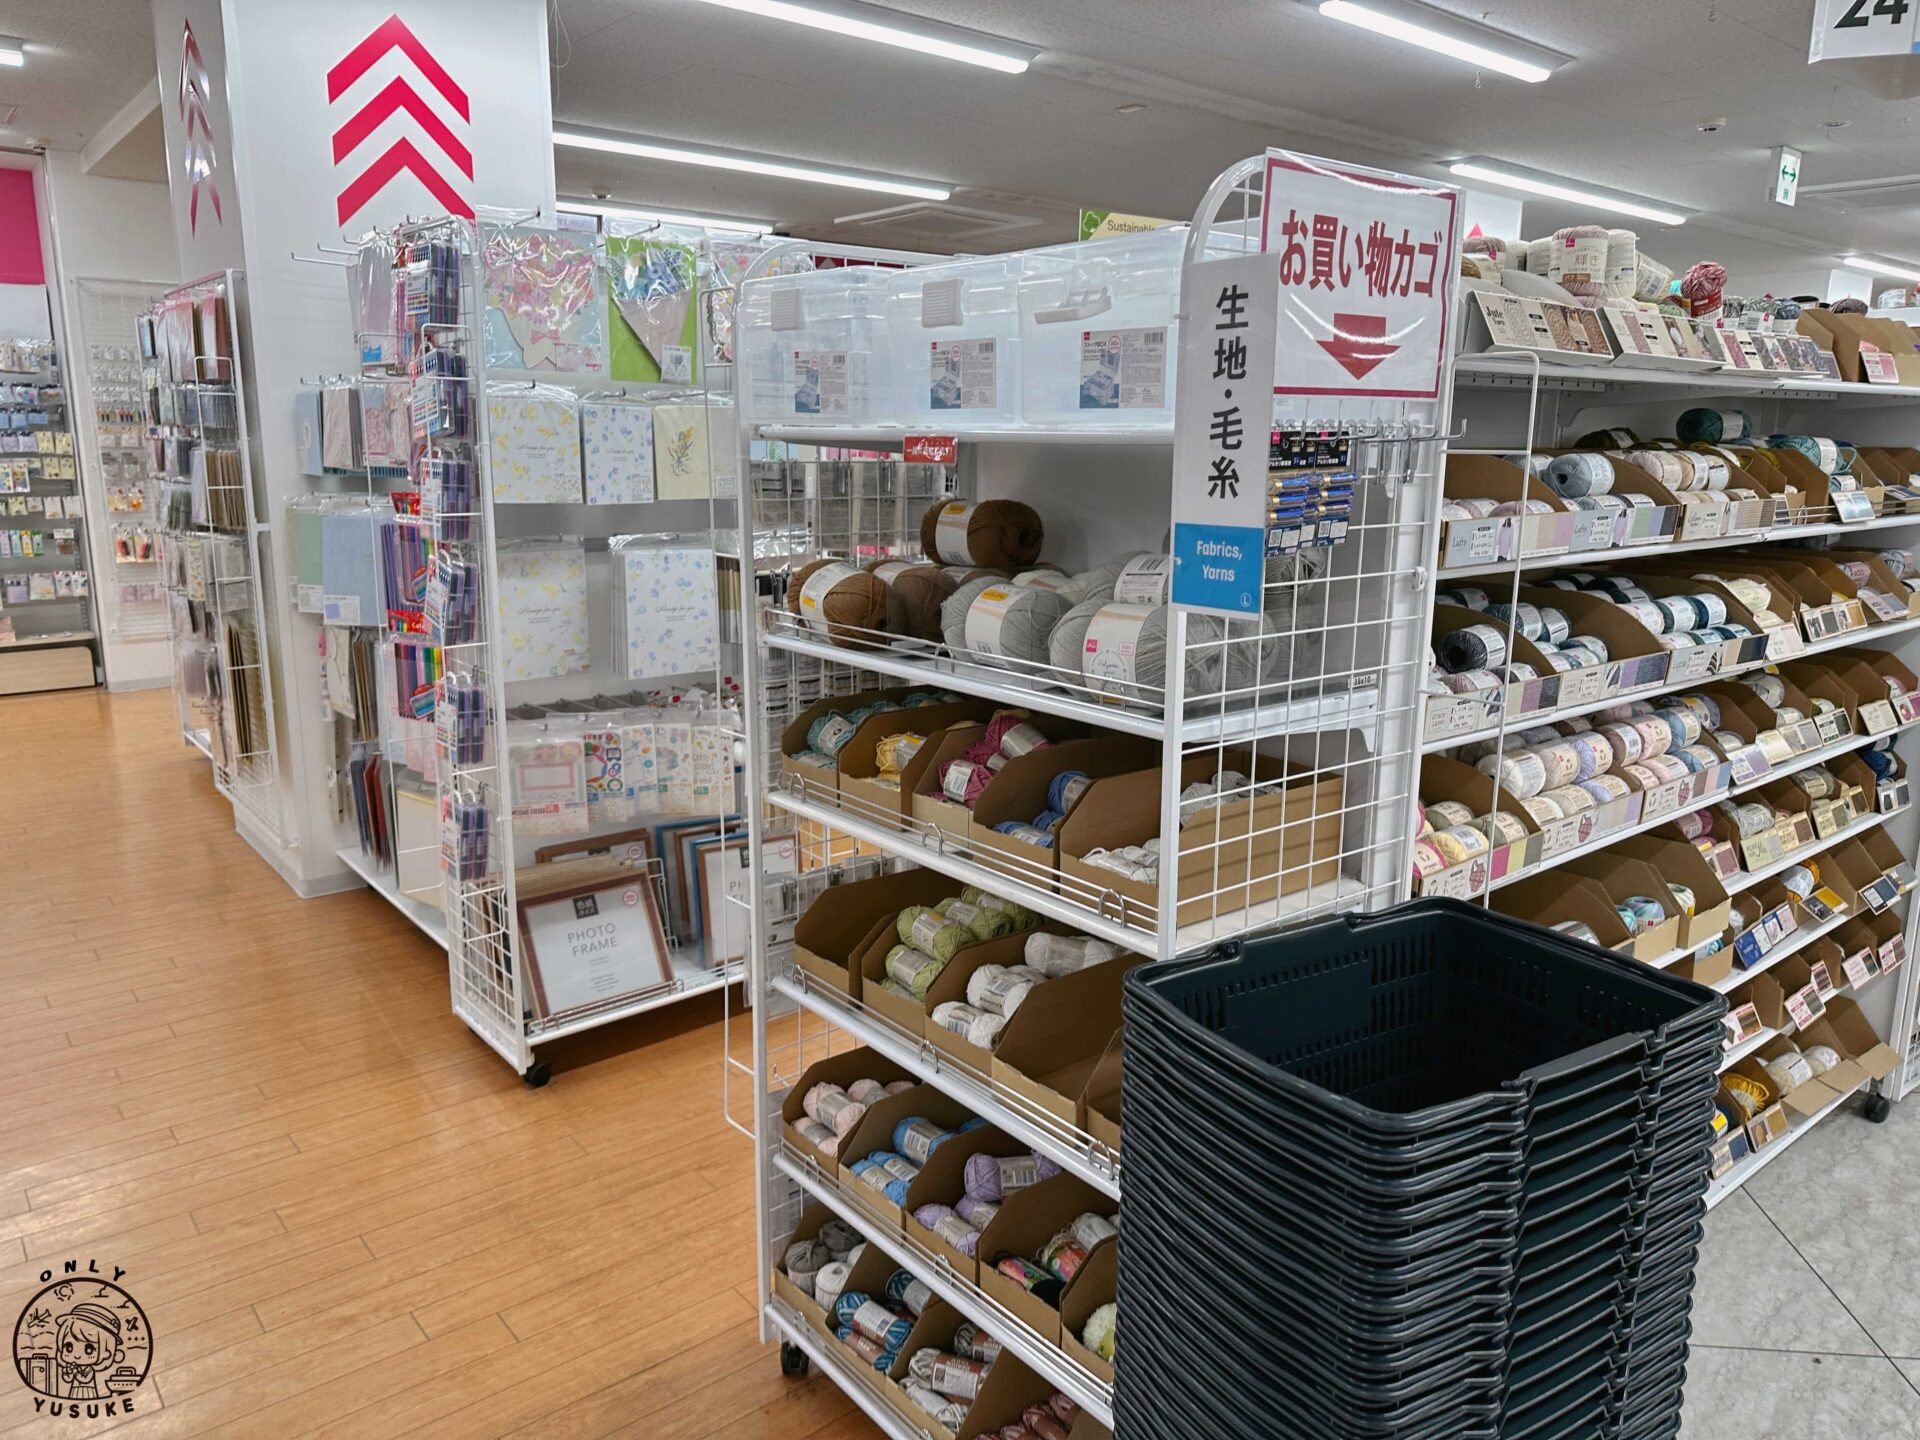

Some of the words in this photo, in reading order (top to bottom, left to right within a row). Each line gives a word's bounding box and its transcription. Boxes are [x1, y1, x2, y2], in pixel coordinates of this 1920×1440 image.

[1279, 209, 1443, 298] お買い物カゴ
[1207, 284, 1249, 500] 生地・毛糸
[1196, 540, 1243, 561] Fabrics,
[1202, 564, 1235, 582] Yarns
[567, 922, 616, 944] PHOTO
[572, 936, 618, 957] FRAME
